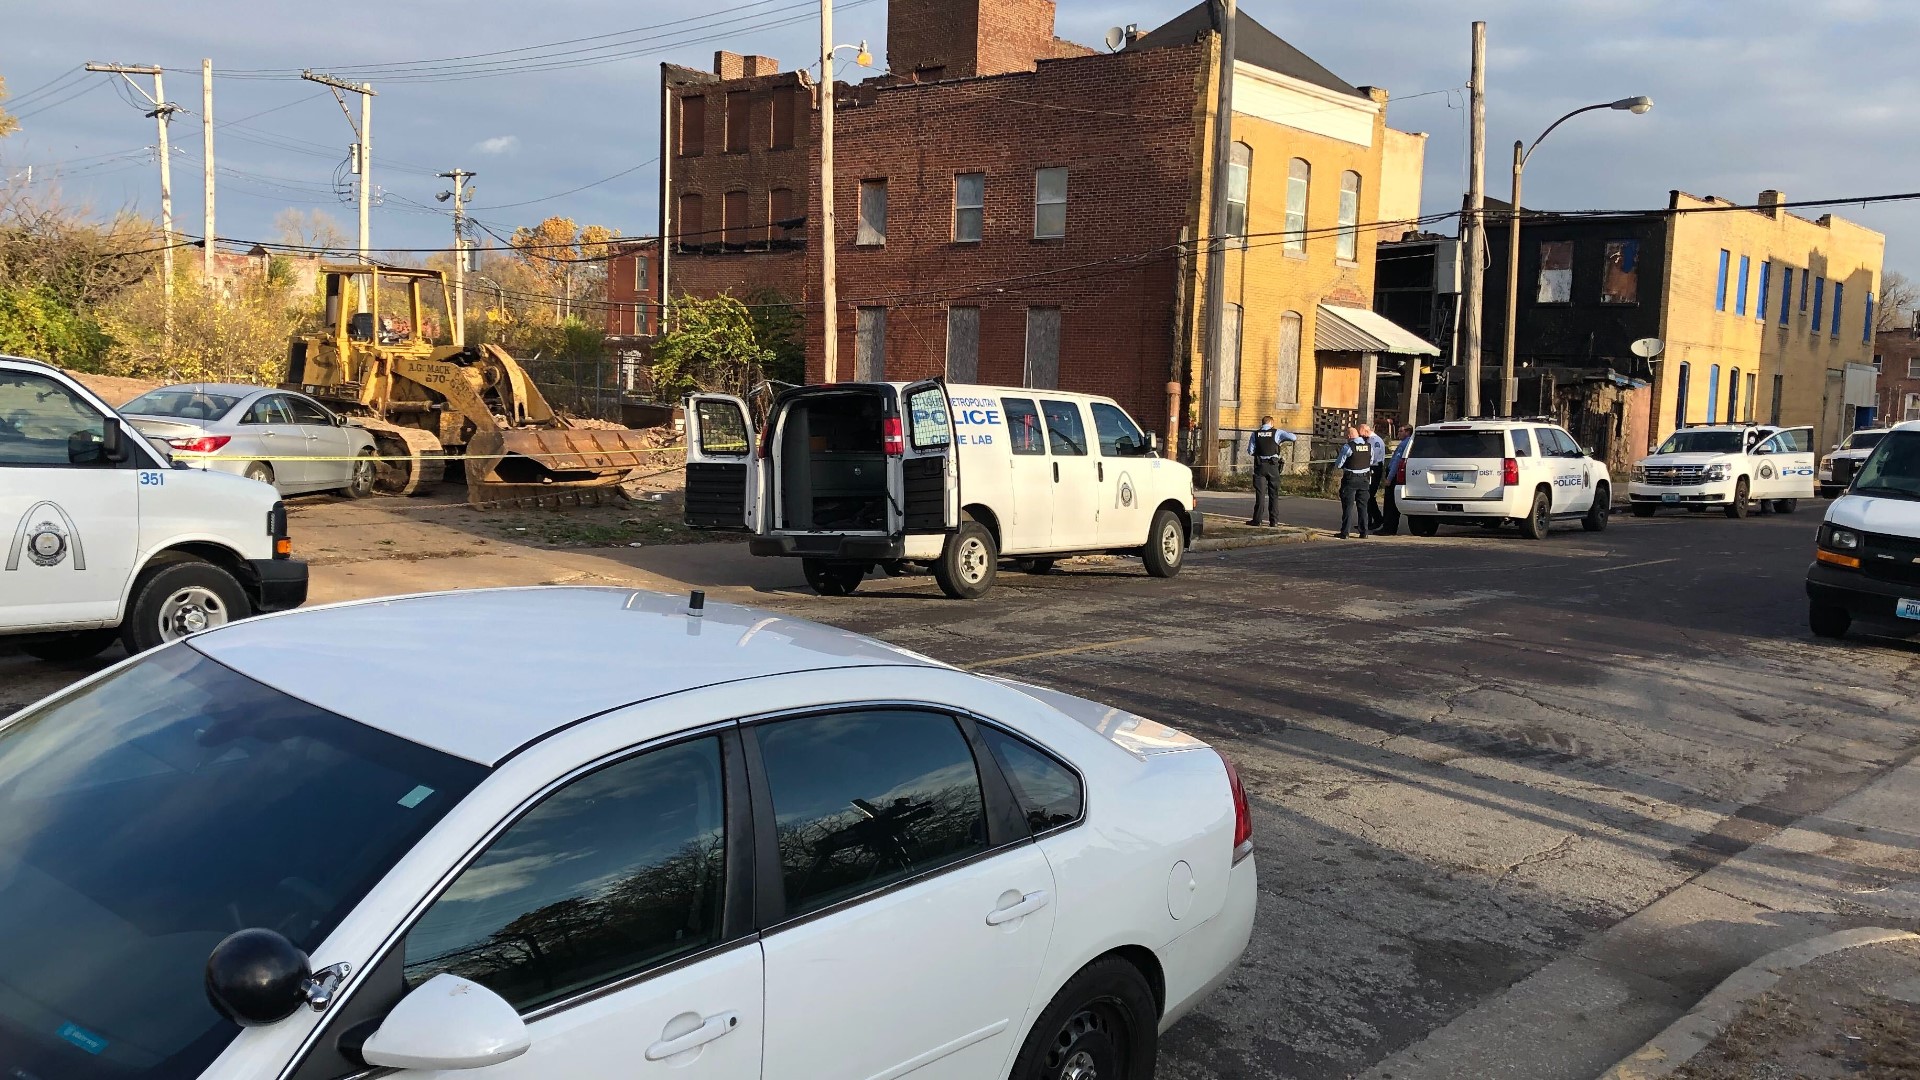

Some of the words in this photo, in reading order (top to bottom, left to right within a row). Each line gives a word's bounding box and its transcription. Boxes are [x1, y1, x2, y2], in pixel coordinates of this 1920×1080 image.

[930, 434, 967, 445] CRE
[972, 434, 993, 445] LAB
[140, 472, 164, 485] 351
[1553, 478, 1582, 487] POLICE
